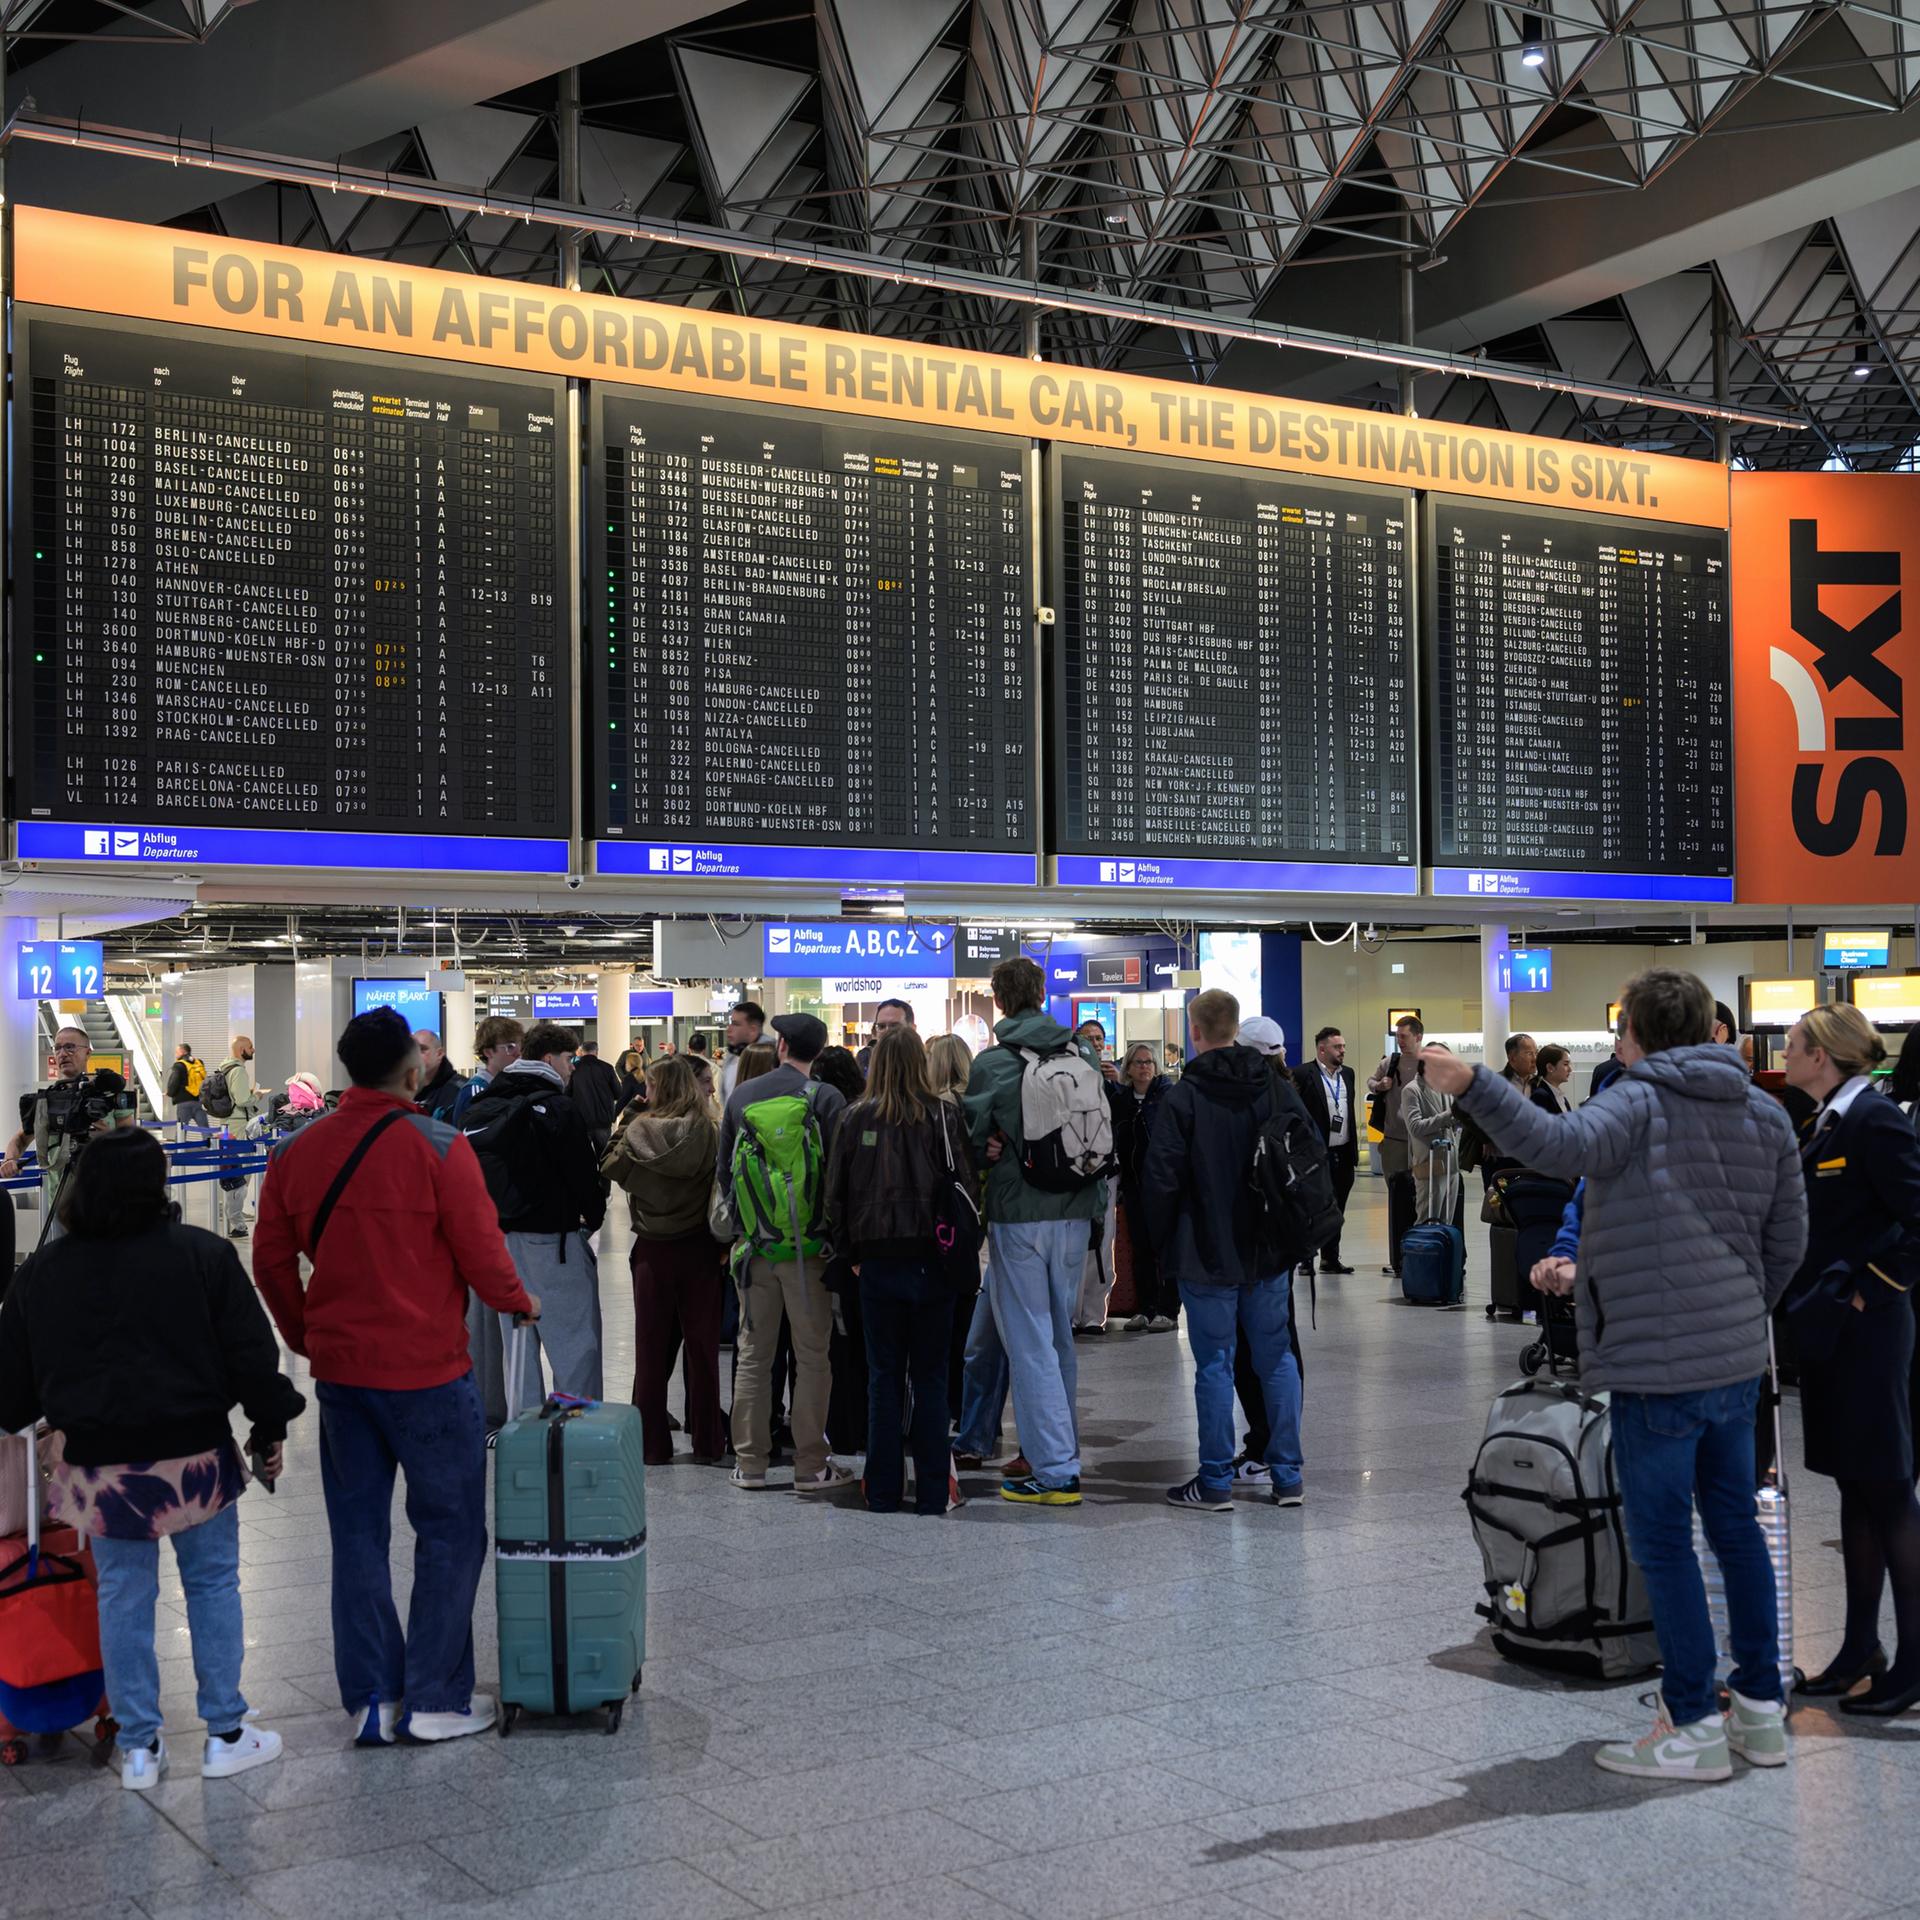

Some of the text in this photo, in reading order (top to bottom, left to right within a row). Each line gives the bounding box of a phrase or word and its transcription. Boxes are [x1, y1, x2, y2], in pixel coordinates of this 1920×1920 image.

[64, 354, 79, 366] Flug
[64, 366, 84, 377] Flight
[154, 366, 170, 376] nach
[173, 246, 1659, 508] FOR AN AFFORDABLE RENTAL CAR, THE DESTINATION IS SIXT.
[154, 378, 162, 386] to
[232, 376, 246, 386] über
[232, 387, 242, 396] via
[333, 401, 364, 412] scheduled
[372, 394, 401, 406] erwartet
[405, 398, 429, 408] Terminal
[372, 406, 404, 417] estimated
[406, 408, 431, 419] Terminal
[436, 402, 450, 412] Halle
[469, 406, 484, 416] Zone
[437, 412, 449, 422] Hall
[528, 413, 554, 426] Flugsteig
[528, 424, 542, 433] Gate
[66, 417, 444, 470] LH 172 BERLIN-CANCELLED A
[155, 444, 308, 471] BRUESSEL-CANCELLED
[632, 451, 830, 484] LH 070 DUESSELDR-CANCELLED
[111, 473, 299, 502] 246 MAILAND-CANCELLED
[660, 484, 804, 510] 3584 DUESSELDORF HBF
[112, 506, 291, 534] 976 DUBLIN-CANCELLED
[668, 515, 818, 540] 972 GLASFOW-CANCELLED
[1084, 504, 1401, 550] EN 8772 LONDON-CITY B30
[633, 526, 1020, 575] LH 1184 ZUERICH A24
[1142, 538, 1192, 552] TASCHKENT
[112, 540, 274, 565] 858 OSLO-CANCELLED
[703, 548, 831, 570] AMSTERDAM-CANCELLED
[1108, 548, 1220, 568] 4123 LONDON-GATWICK
[1455, 548, 1576, 570] LH 178 BERLIN-CANCELLED
[1142, 565, 1164, 576] GRAZ
[67, 553, 82, 564] LH
[104, 556, 136, 569] 1278
[156, 561, 198, 574] ATHEN
[531, 594, 552, 606] B19
[632, 572, 825, 599] DE 4087 BERLIN-BRANDENBURG
[156, 578, 308, 600] HANNOVER-CANCELLED
[1143, 578, 1226, 595] WROCLAW/BRESLAU
[1143, 592, 1182, 604] SEVILLA
[1475, 588, 1545, 603] 8750 LUXEMBURG
[1503, 603, 1582, 619] DRESDEN-CANCELLED
[633, 602, 1020, 644] 4Y 2154 GRAN CANARIA B11
[1144, 618, 1214, 633] STUTTGART HBF
[704, 638, 731, 649] WIEN
[104, 640, 325, 666] 3640 HAMBURG-MUENSTER-OSN
[662, 649, 688, 661] 8852
[112, 658, 224, 676] 094 MUENCHEN
[705, 667, 731, 678] PISA
[1144, 658, 1238, 674] PALMA DE MALLORCA
[1504, 664, 1536, 674] ZUERICH
[1787, 519, 1907, 857] SIXT
[105, 692, 308, 714] 1346 WARSCHAU-CANCELLED
[1506, 701, 1541, 711] ISTANBUL
[1145, 712, 1216, 726] LEIPZIG/HALLE
[634, 723, 752, 739] XQ 141 ANTALYA
[1145, 726, 1194, 737] LJUBLJANA
[1505, 724, 1541, 736] BRUESSEL
[1146, 740, 1166, 749] LINZ
[105, 759, 284, 778] 1026 PARIS-CANCELLED
[706, 772, 833, 787] KOPENHAGE-CANCELLED
[1506, 774, 1528, 783] BASEL
[635, 784, 731, 796] LX 1081 GENF
[67, 791, 317, 811] VL 1124 BARCELONA-CANCELLED
[1146, 806, 1250, 819] GOETEBORG-CANCELLED
[143, 832, 176, 846] Abflug
[1507, 835, 1543, 844] MUENCHEN
[143, 846, 198, 859] Departures
[696, 850, 722, 862] Abflug
[696, 862, 740, 874] Departures
[1138, 863, 1160, 874] Abflug
[1138, 874, 1174, 884] Departures
[1500, 875, 1518, 885] Abflug
[1500, 884, 1530, 894] Departures
[794, 929, 823, 942] Abflug
[794, 943, 842, 954] Departures
[845, 929, 919, 958] A,B,C,Z
[30, 966, 52, 994] 12
[72, 966, 98, 994] 12
[1054, 968, 1078, 981] Change
[1101, 972, 1123, 982] Travelex
[1503, 968, 1510, 989] 11
[1528, 967, 1547, 988] 11
[835, 978, 928, 993] worldshop Lufthansa
[366, 990, 396, 1001] NÄHER
[572, 996, 580, 1007] A
